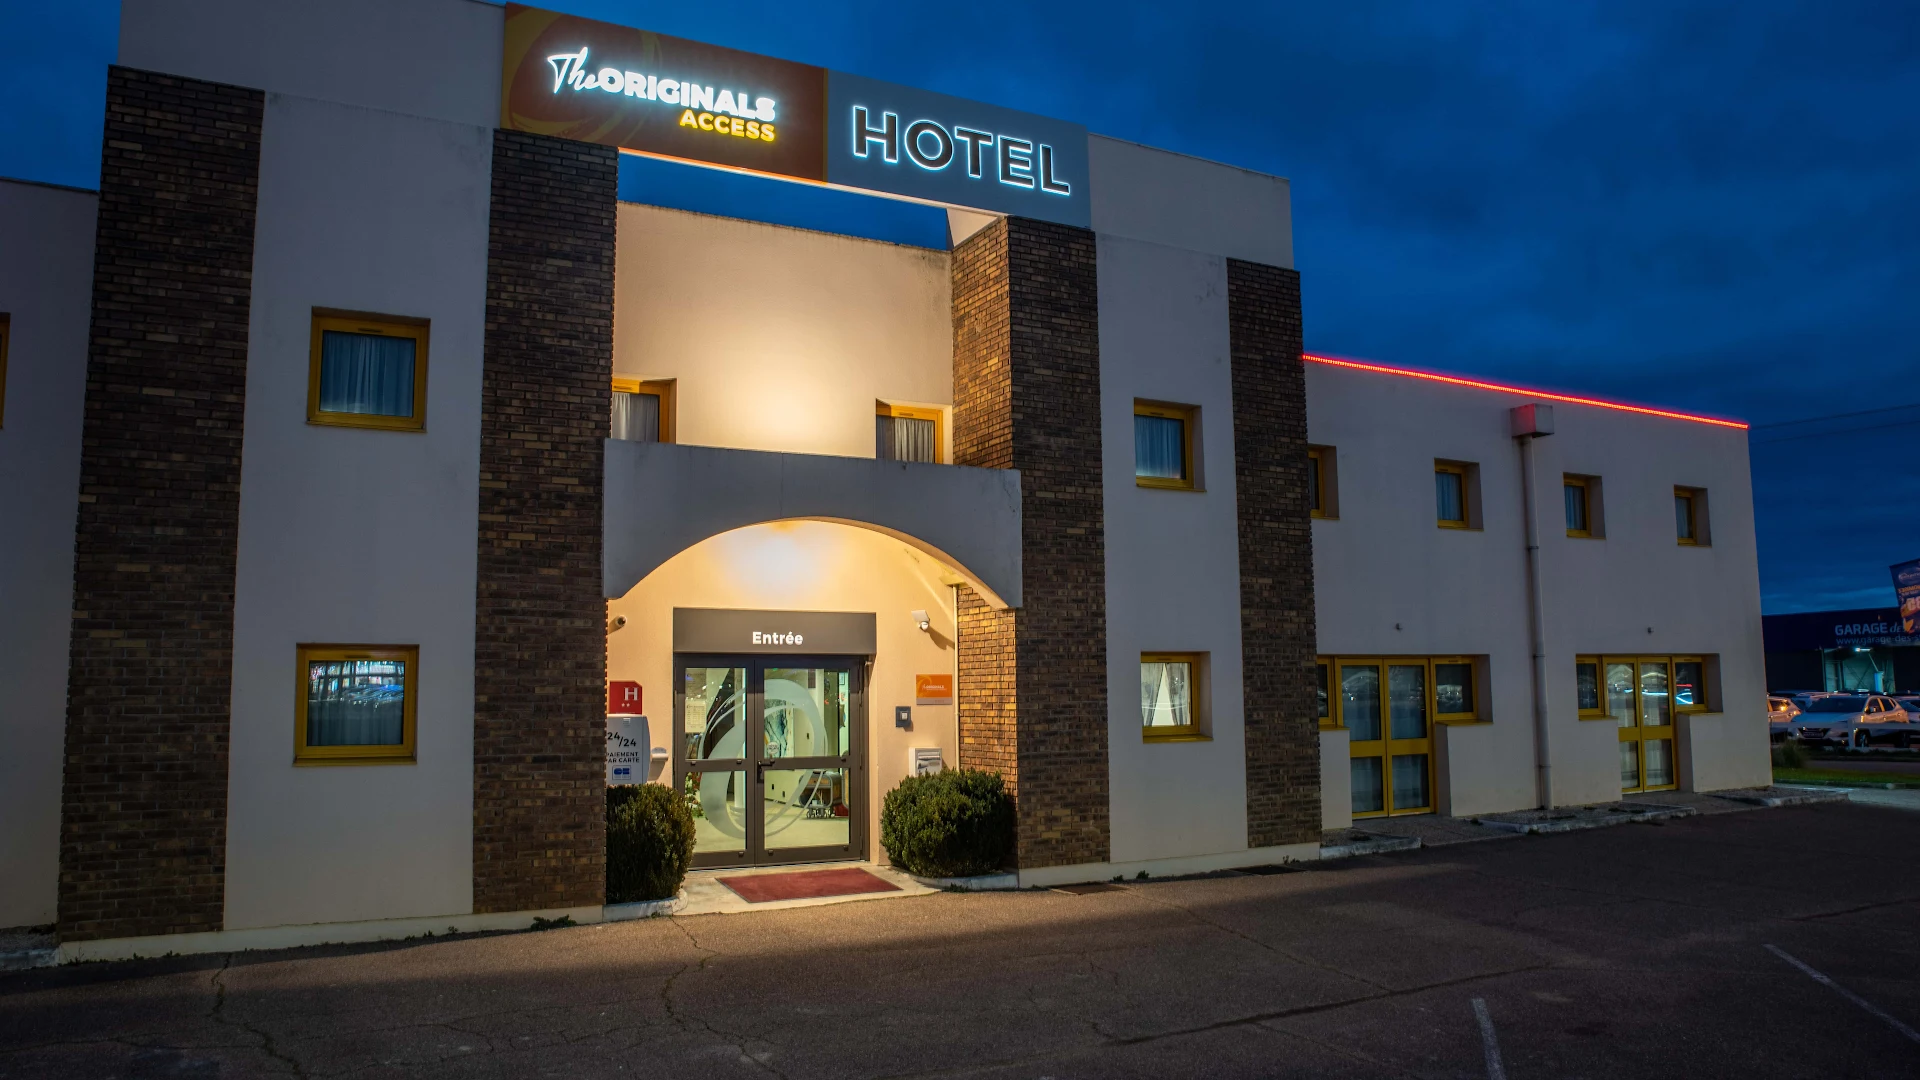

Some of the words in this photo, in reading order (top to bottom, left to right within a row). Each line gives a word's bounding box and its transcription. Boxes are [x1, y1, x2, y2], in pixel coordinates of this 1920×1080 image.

[598, 67, 776, 122] ORIGINALS
[679, 109, 776, 142] ACCESS
[852, 105, 1071, 196] HOTEL
[1834, 622, 1889, 636] GARAGE
[752, 631, 804, 646] Entrée
[624, 687, 638, 701] H
[607, 731, 637, 748] 24/24
[618, 756, 640, 764] CARTE
